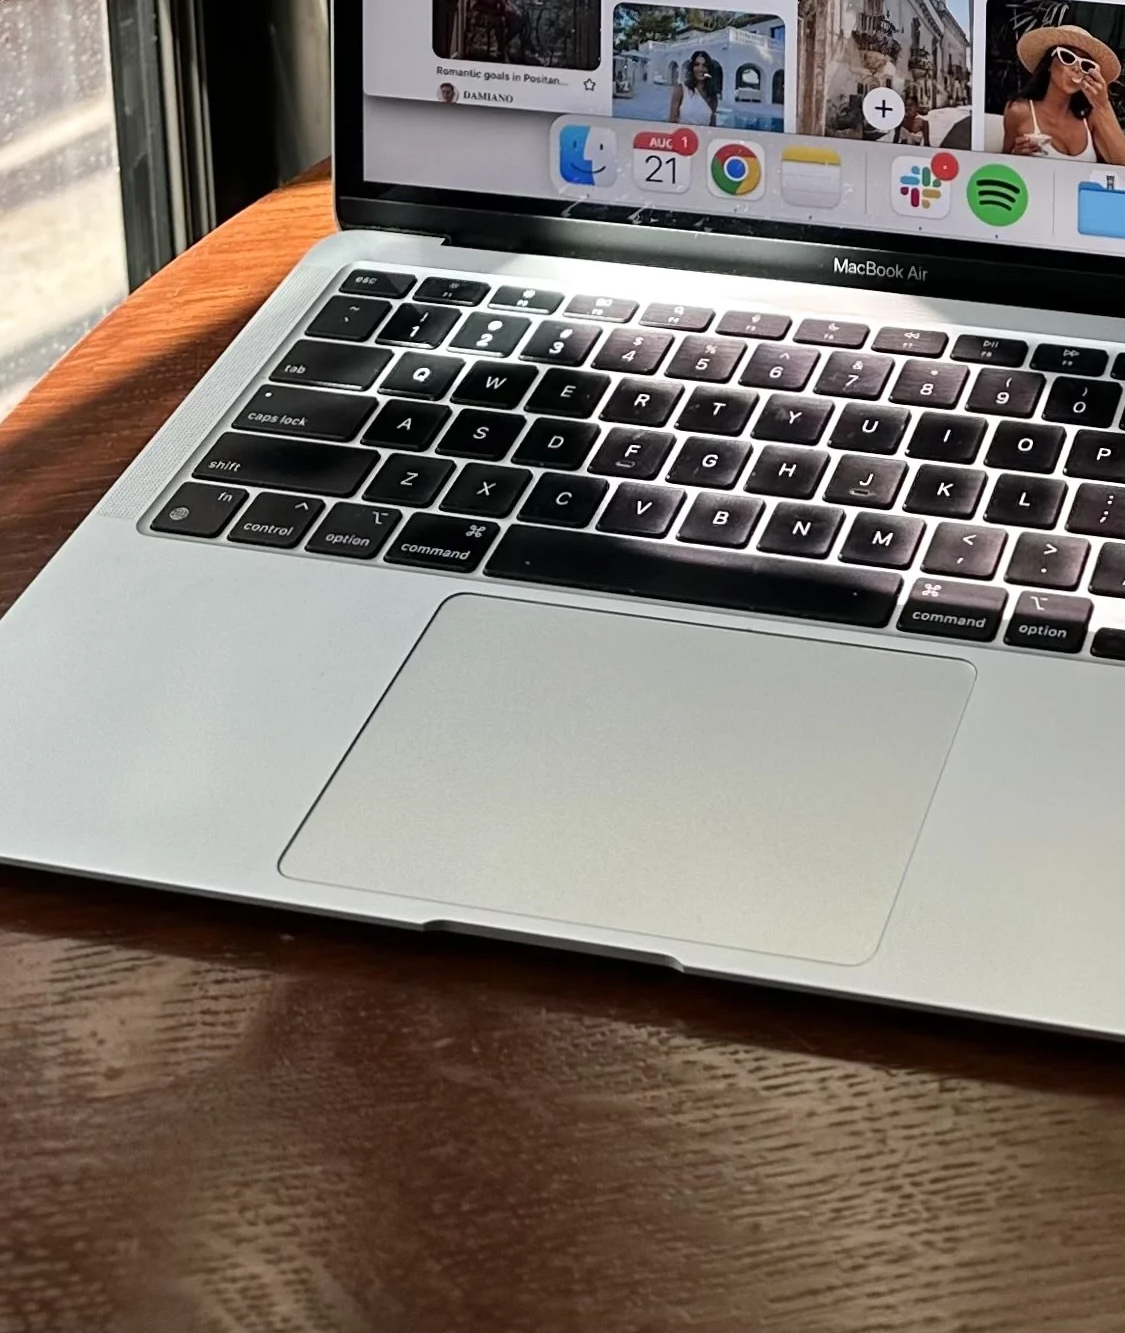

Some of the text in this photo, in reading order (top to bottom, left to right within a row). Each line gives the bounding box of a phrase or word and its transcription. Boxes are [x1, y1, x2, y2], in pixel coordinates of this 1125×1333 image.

[436, 66, 482, 78] Romantic
[484, 71, 510, 81] goals
[512, 72, 520, 81] in
[463, 91, 513, 103] DAMIANO
[681, 136, 688, 147] 1
[645, 155, 676, 184] 21
[833, 257, 929, 282] MacBook Air
[355, 276, 378, 284] esc
[410, 326, 420, 337] 1
[476, 334, 493, 346] 2
[548, 342, 564, 354] 3
[622, 350, 636, 362] 4
[284, 365, 306, 374] tab
[695, 358, 710, 370] 5
[413, 367, 431, 381] Q
[769, 367, 784, 378] 6
[486, 377, 507, 389] W
[845, 375, 859, 387] 7
[560, 385, 576, 397] E
[920, 384, 933, 395] 8
[634, 394, 650, 407] R
[996, 392, 1009, 404] 9
[712, 403, 727, 415] T
[1073, 402, 1086, 413] 0
[248, 411, 306, 427] caps lock
[397, 417, 412, 430] A
[787, 411, 802, 424] Y
[472, 427, 489, 439] S
[862, 420, 879, 433] U
[548, 435, 564, 449] D
[943, 430, 951, 442] I
[624, 445, 641, 457] F
[1017, 438, 1034, 452] O
[702, 454, 718, 467] G
[1096, 448, 1112, 460] P
[208, 460, 241, 472] shift
[778, 463, 797, 477] H
[400, 472, 418, 485] Z
[859, 473, 874, 486] J
[477, 482, 496, 496] X
[937, 483, 954, 497] K
[217, 492, 233, 502] fn
[556, 492, 572, 505] C
[1018, 492, 1031, 507] L
[636, 501, 652, 515] V
[712, 511, 729, 525] B
[243, 521, 294, 536] control
[792, 522, 810, 536] N
[325, 532, 370, 547] option
[871, 531, 894, 547] M
[401, 542, 470, 561] command
[912, 610, 987, 629] command
[1019, 623, 1067, 638] option
